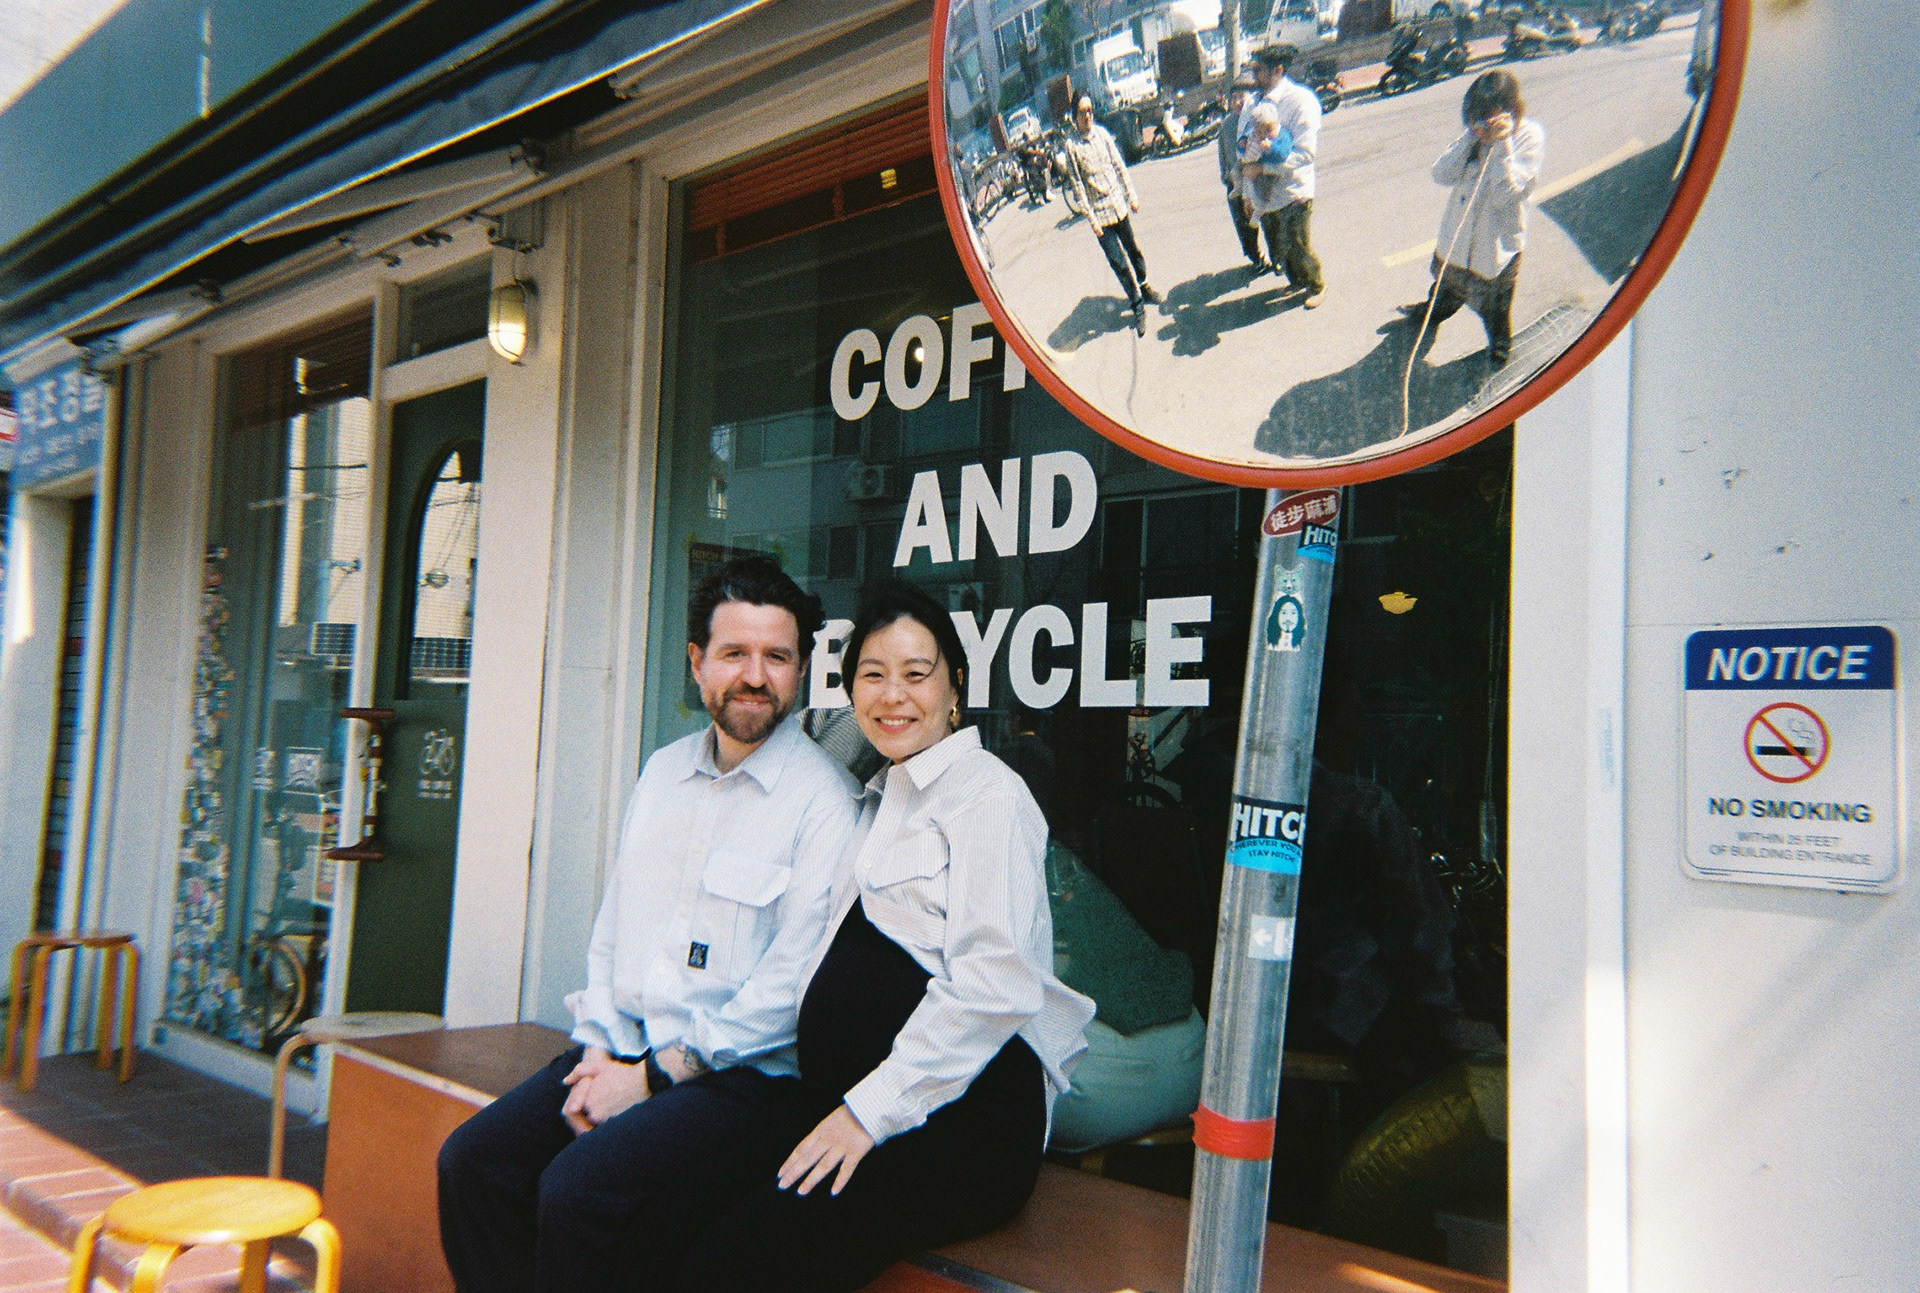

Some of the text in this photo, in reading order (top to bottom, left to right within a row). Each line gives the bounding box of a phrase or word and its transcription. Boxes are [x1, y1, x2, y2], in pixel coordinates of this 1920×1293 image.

[893, 450, 1097, 567] AND
[809, 596, 1212, 709] BYCLE
[1706, 645, 1873, 681] NOTICE
[1708, 797, 1873, 823] NO SMOKING
[1709, 844, 1872, 865] OF BUILDING ENTRANCE
[1737, 831, 1784, 844] WITHIN
[1805, 834, 1840, 847] FEET
